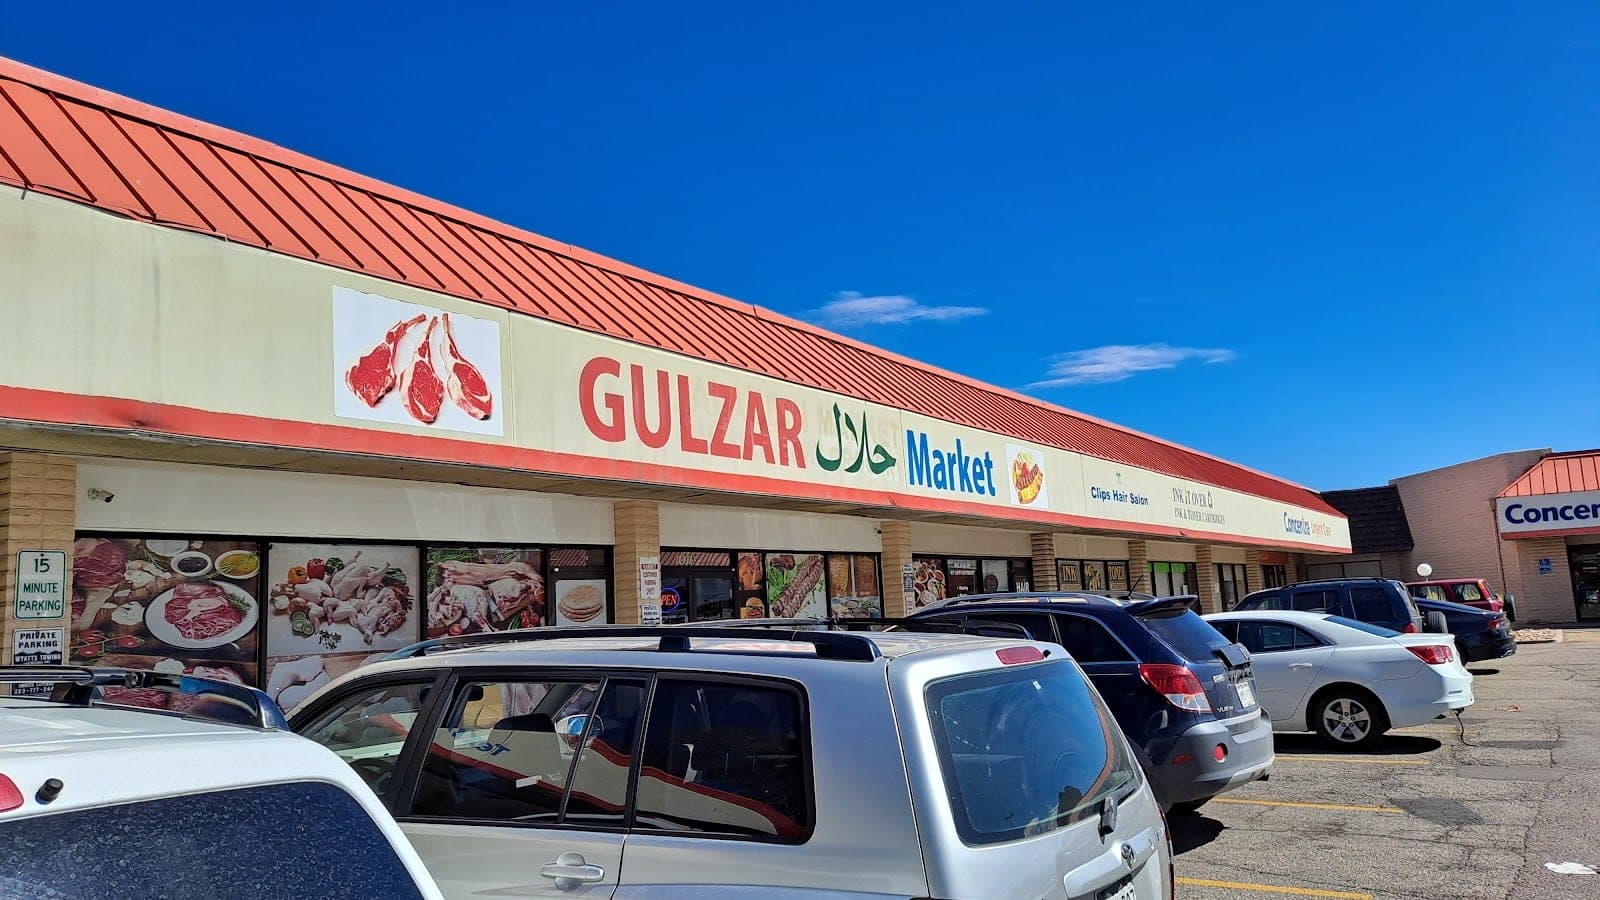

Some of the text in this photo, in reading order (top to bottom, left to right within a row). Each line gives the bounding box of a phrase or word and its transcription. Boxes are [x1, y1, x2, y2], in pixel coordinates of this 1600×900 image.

[578, 356, 806, 469] GULZAR
[815, 401, 897, 475] حلال
[906, 429, 996, 497] Market
[1091, 486, 1149, 506] Clips Hair Salon
[1172, 487, 1184, 503] INK
[34, 558, 50, 573] 15
[1062, 565, 1077, 581] INK
[23, 582, 58, 594] MINUTE
[1016, 581, 1030, 593] HAIR
[19, 600, 61, 612] PARKING
[661, 594, 677, 606] PEN
[20, 631, 57, 640] PRIVATE
[18, 640, 58, 649] PARKING
